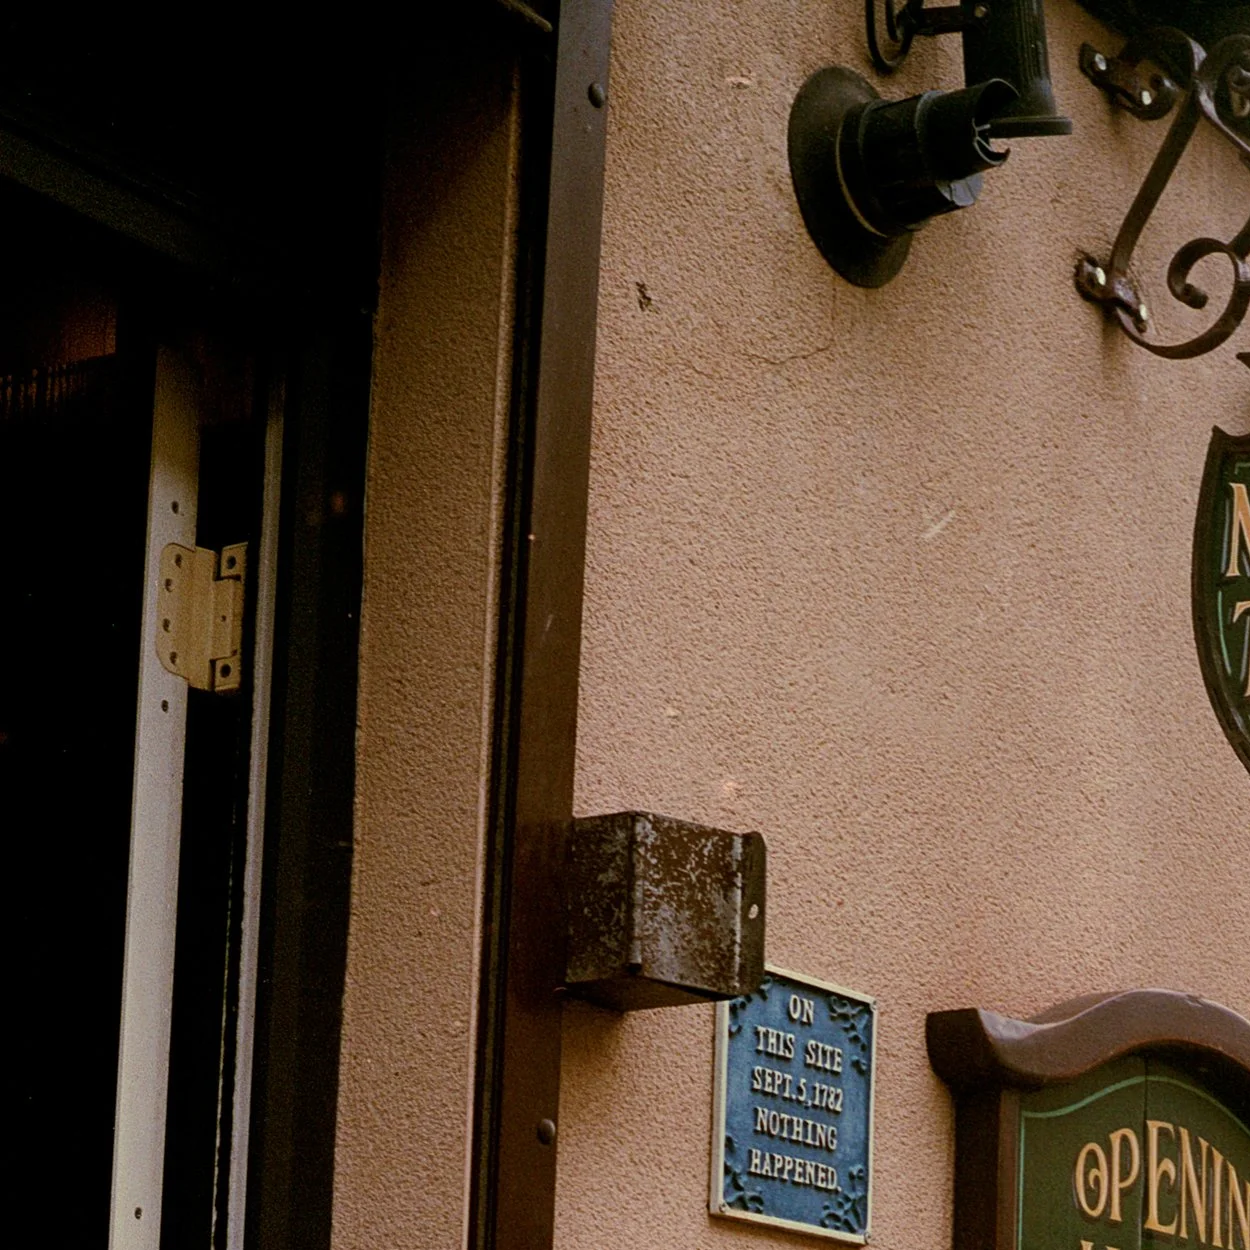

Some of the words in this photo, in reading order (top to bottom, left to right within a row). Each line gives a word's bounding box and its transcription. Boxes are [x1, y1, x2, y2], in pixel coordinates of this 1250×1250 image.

[789, 994, 815, 1023] ON
[755, 1025, 795, 1059] THIS
[805, 1039, 843, 1073] SITE
[755, 1107, 838, 1150] NOTHING
[751, 1150, 842, 1191] HAPPENED.
